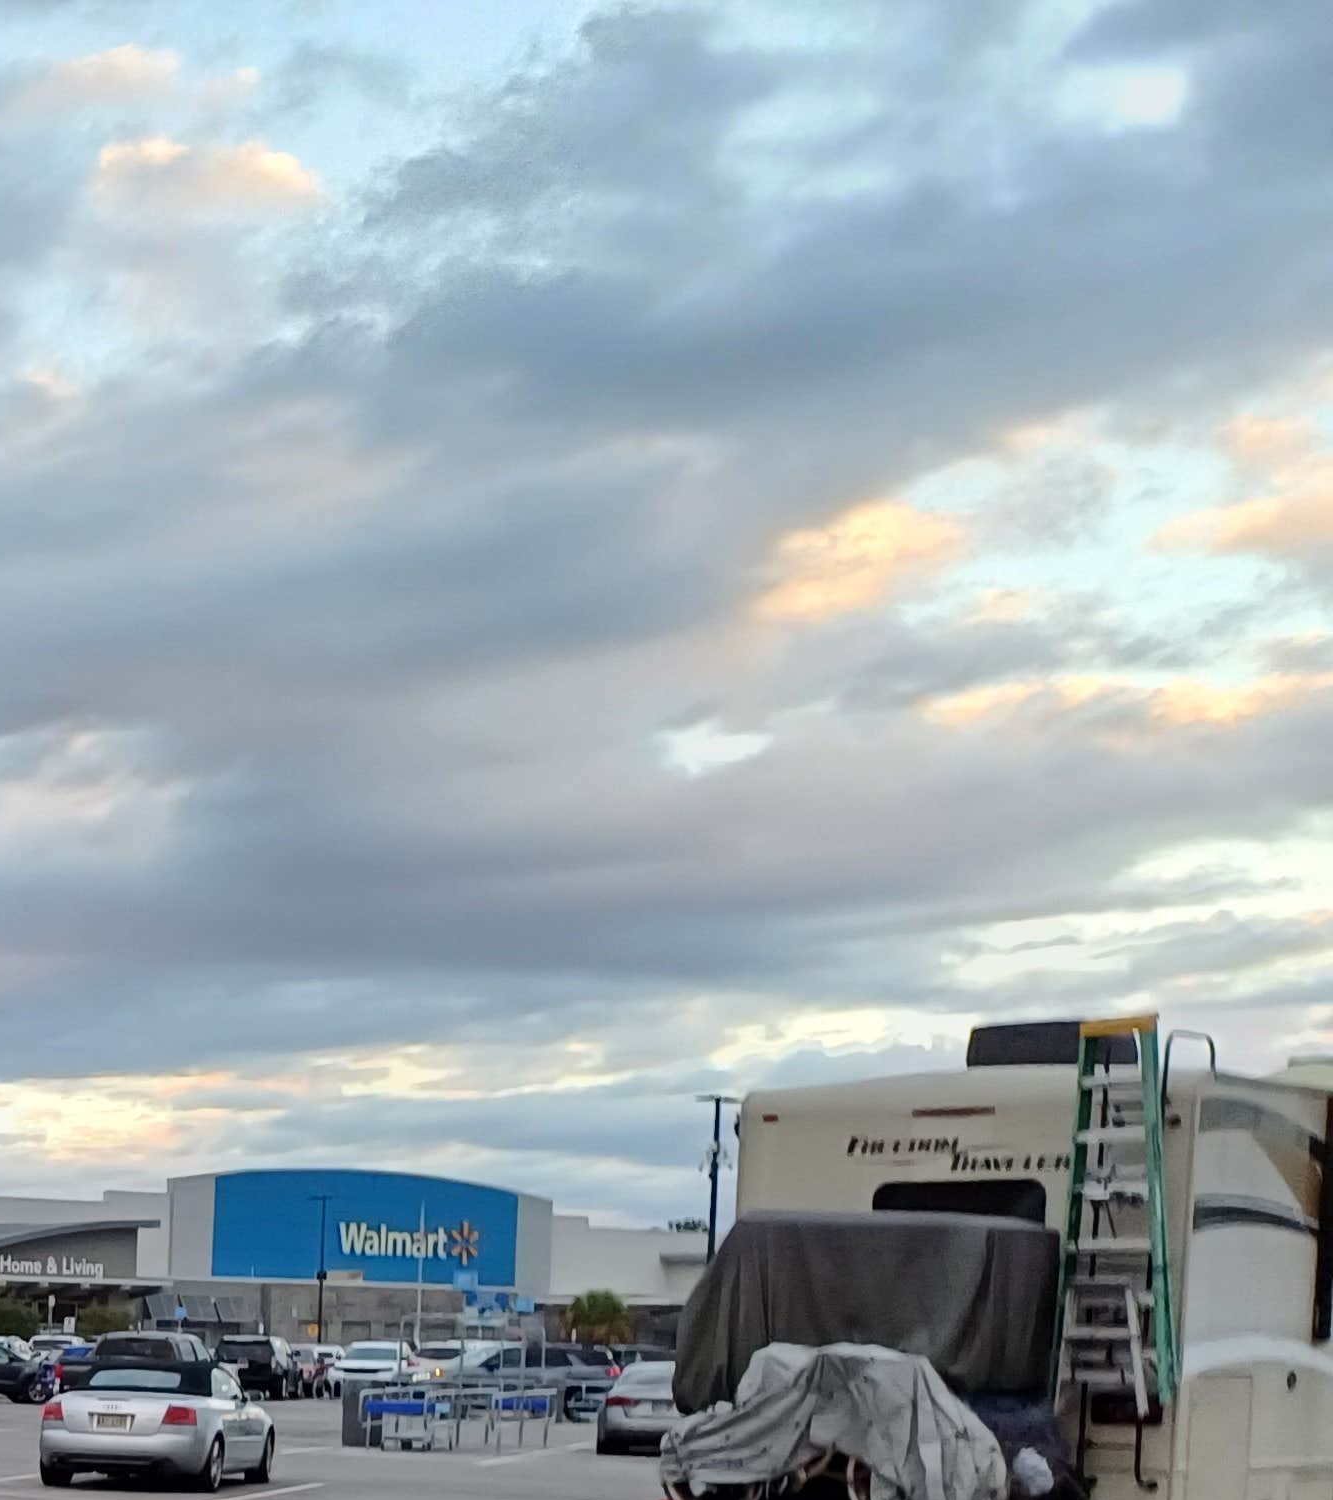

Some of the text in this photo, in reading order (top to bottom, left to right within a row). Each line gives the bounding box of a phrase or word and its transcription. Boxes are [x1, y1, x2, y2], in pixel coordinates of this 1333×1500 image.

[339, 1221, 448, 1260] Walmart
[0, 1254, 104, 1281] Home & Living
